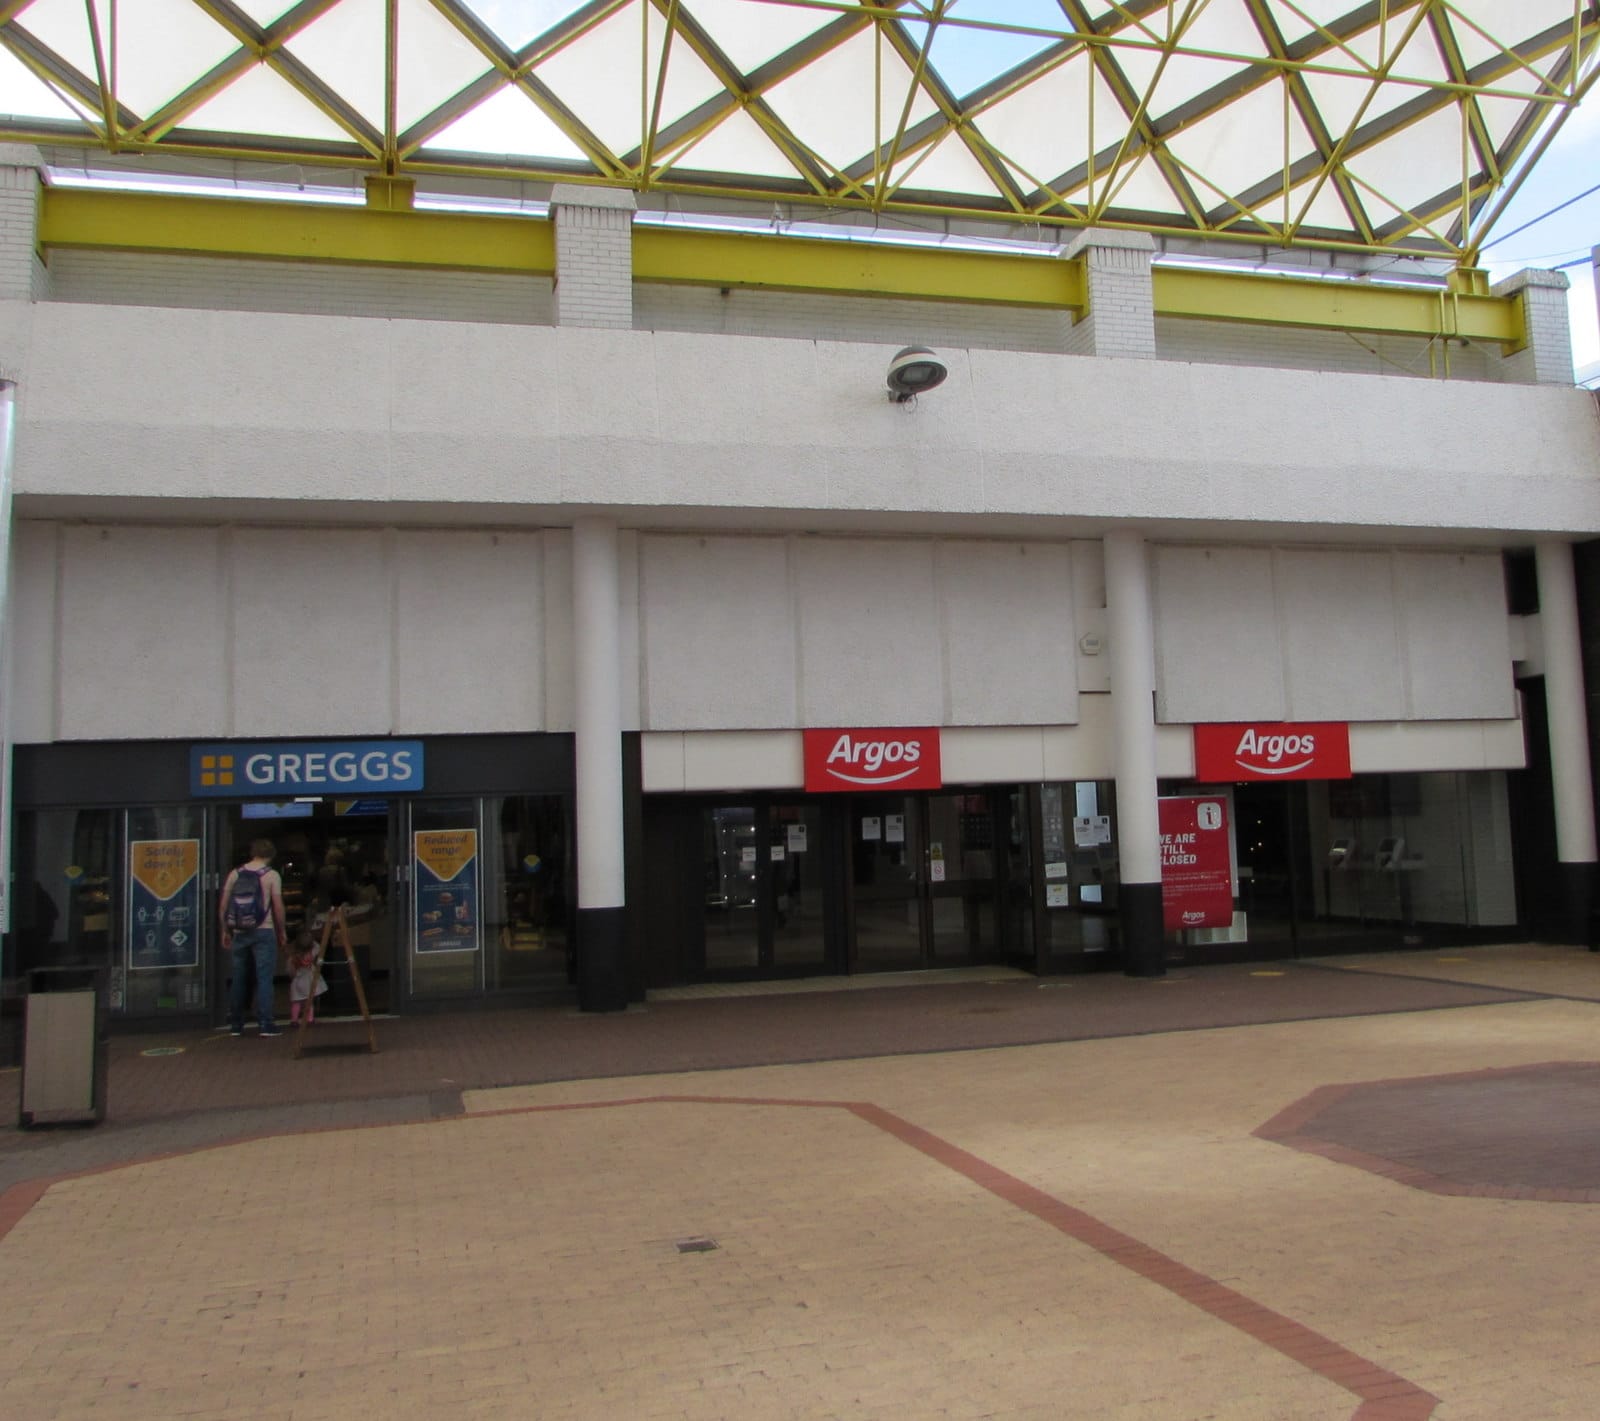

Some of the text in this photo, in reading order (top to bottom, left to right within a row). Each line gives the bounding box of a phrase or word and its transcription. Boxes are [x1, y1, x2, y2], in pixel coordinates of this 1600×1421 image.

[827, 735, 921, 771] Argos
[1235, 729, 1315, 762] Argos
[246, 752, 413, 785] GREGGS
[1175, 833, 1196, 844] ARE
[1182, 911, 1206, 920] Argos
